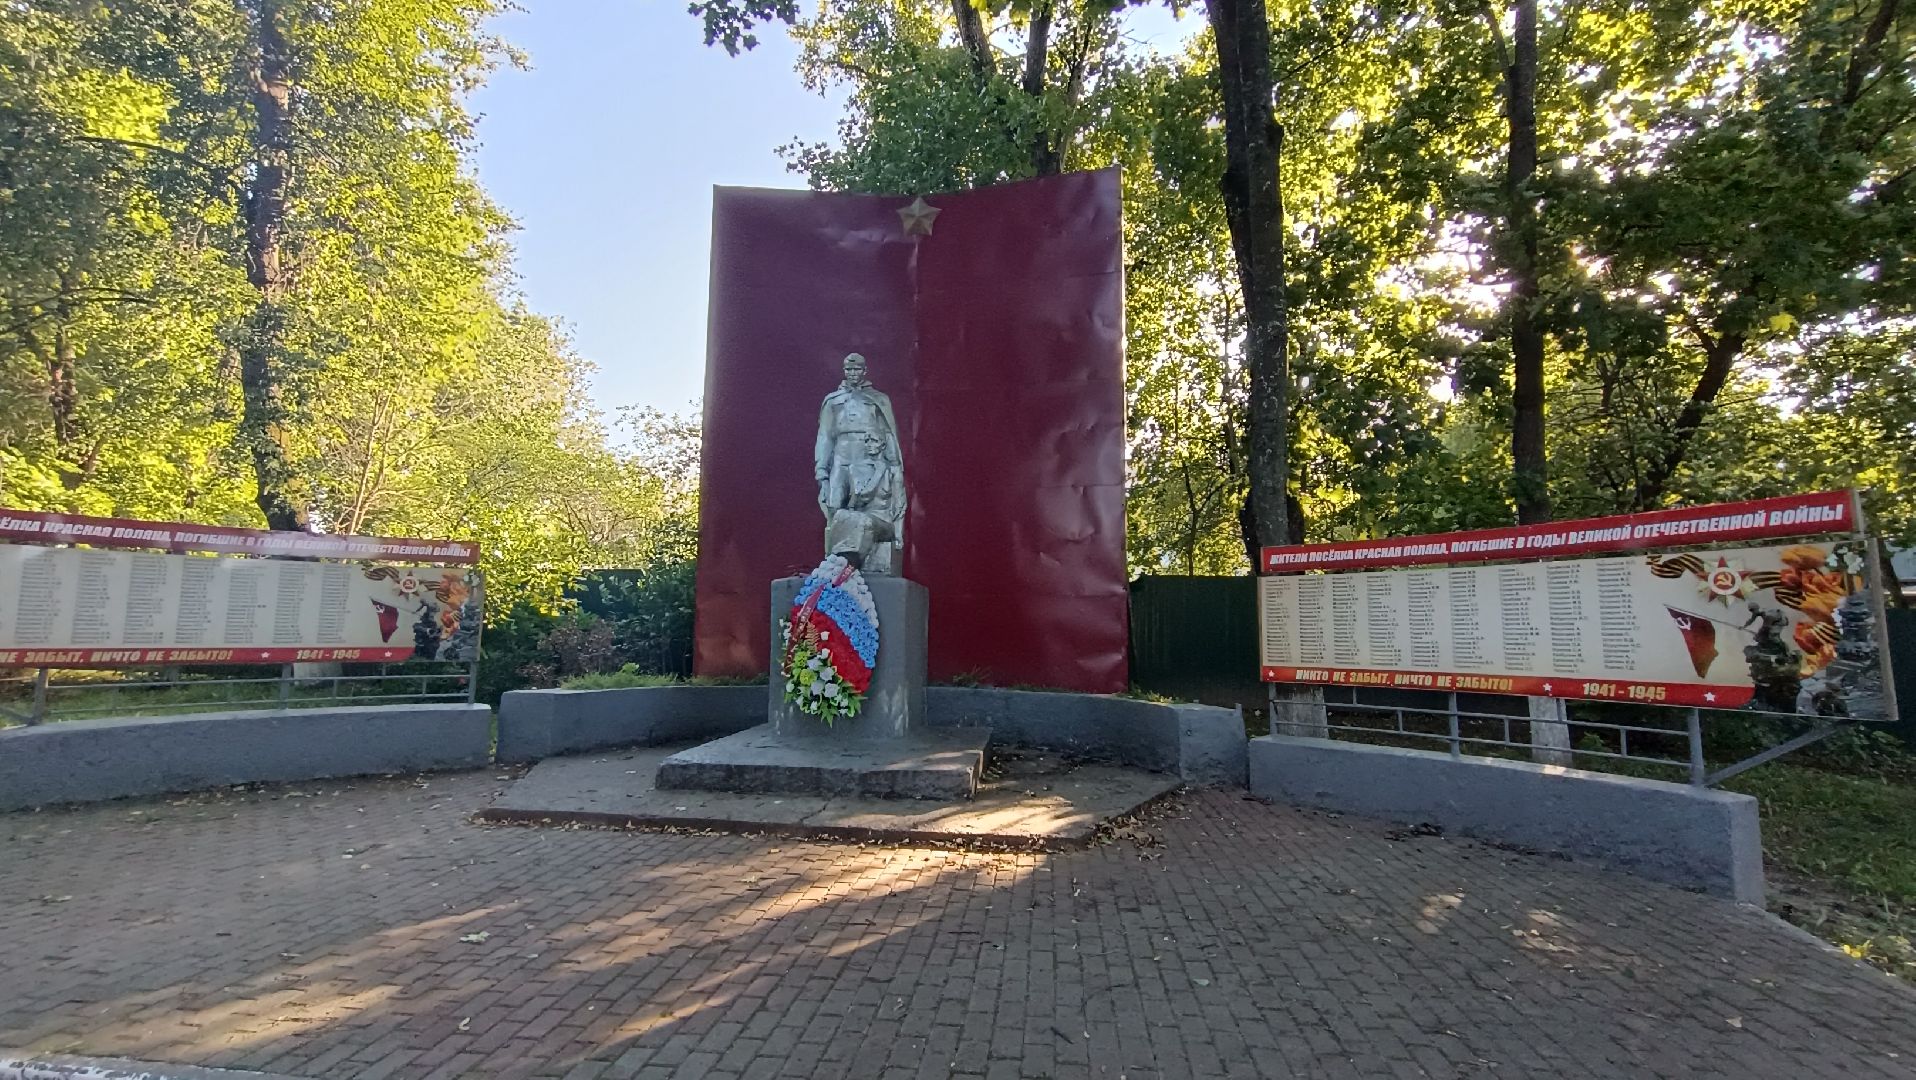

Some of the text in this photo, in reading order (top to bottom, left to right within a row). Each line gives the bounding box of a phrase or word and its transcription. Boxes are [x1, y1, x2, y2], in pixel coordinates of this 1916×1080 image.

[0, 516, 41, 531] ЁЛКА
[42, 521, 112, 537] КРАСНАЯ
[113, 527, 171, 542] ПОЛЯНА,
[174, 531, 245, 546] ПОГИБШИЕ
[433, 543, 471, 557] ВОЙНЫ
[1269, 503, 1844, 565] ЖИТЕЛИ ПОСЁЛКА КРАСНАЯ ПОЛЯНА, ПОГИБШИЕ В ГОДЫ ВЕЛИКОЙ ОТЕЧЕСТВЕННОЙ ВОЙНЫ
[23, 652, 84, 663] ЗАБЫТ,
[90, 650, 141, 662] НИЧТО
[146, 650, 163, 661] НЕ
[169, 650, 233, 661] ЗАБЫТО!
[296, 649, 324, 660] 1941
[331, 649, 360, 660] 1945
[1295, 669, 1513, 691] НИКТО НЕ ЗАБЫТ, НИЧТО НЕ ЗАБЫТО!
[1583, 682, 1615, 697] 1941
[1627, 685, 1666, 700] 1945
